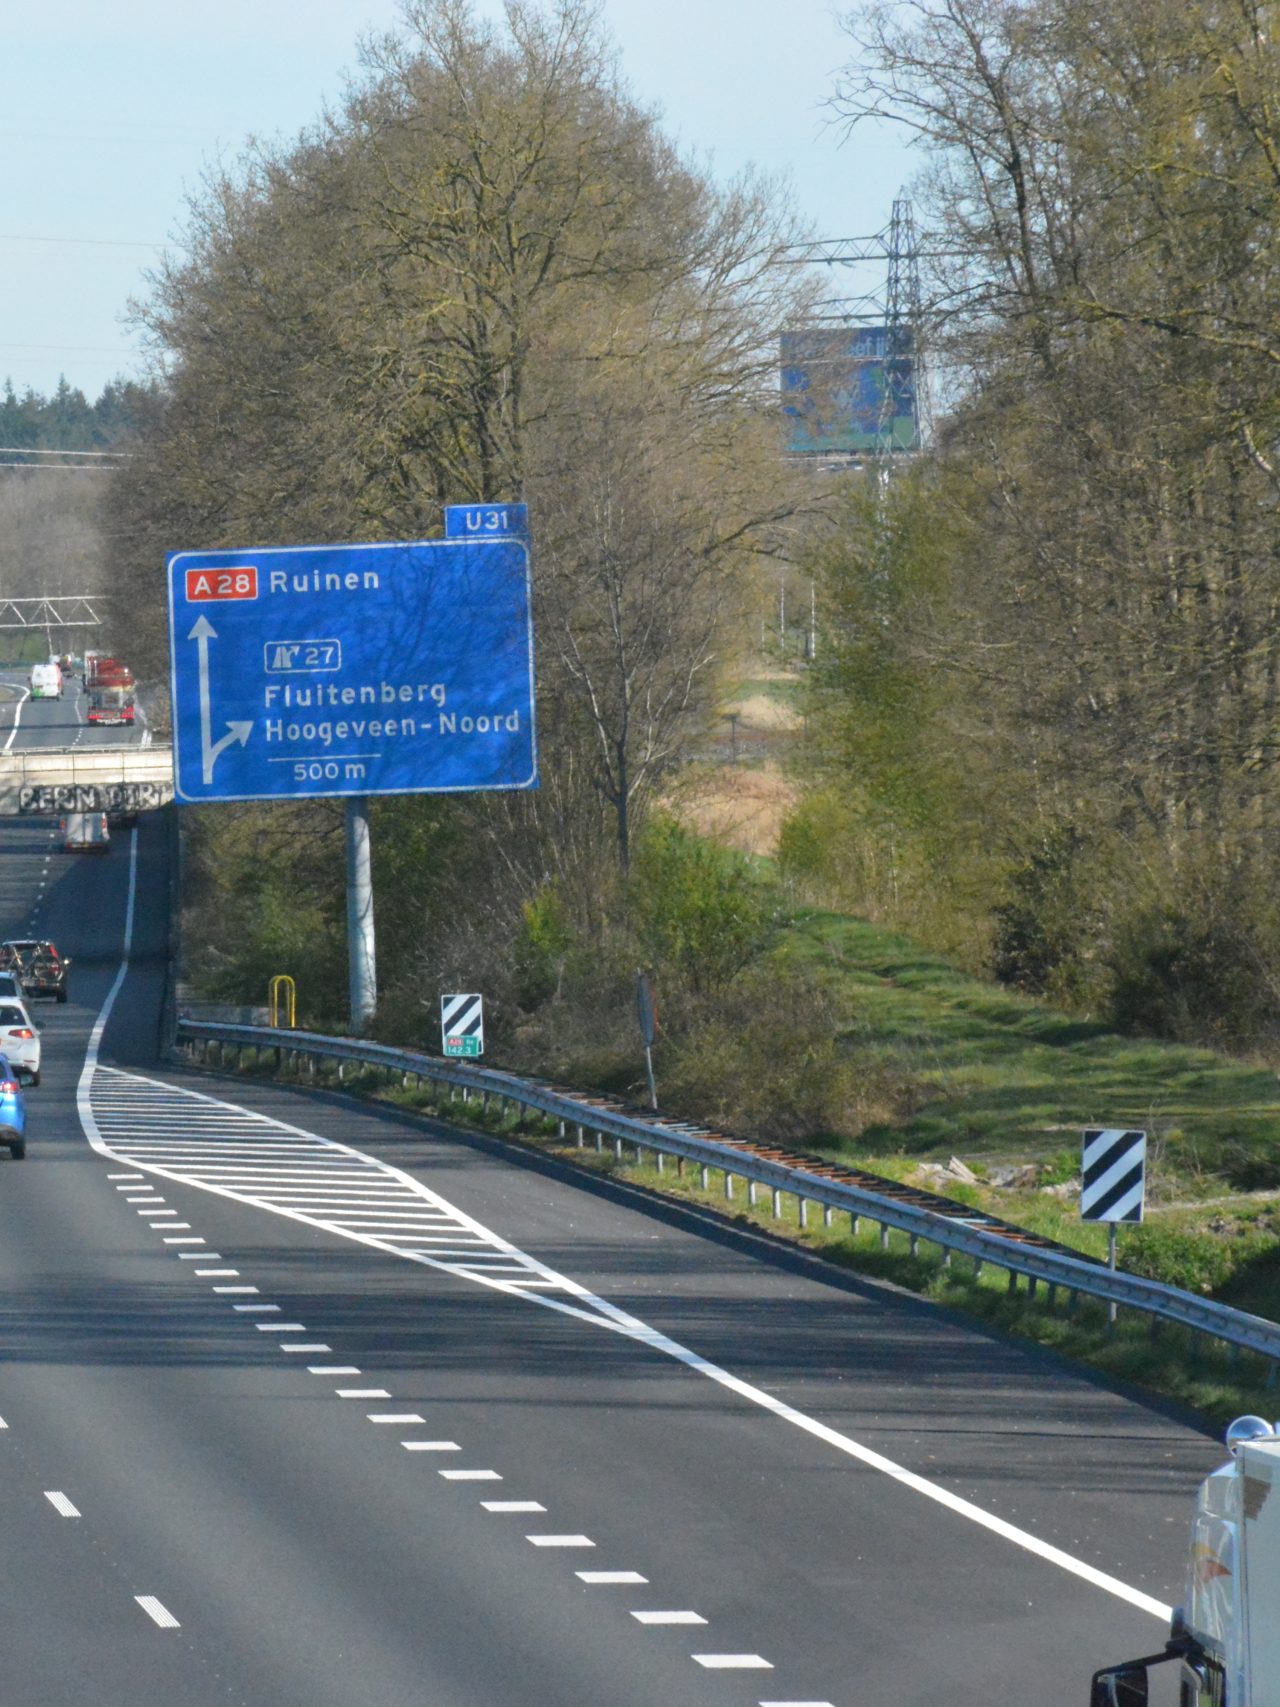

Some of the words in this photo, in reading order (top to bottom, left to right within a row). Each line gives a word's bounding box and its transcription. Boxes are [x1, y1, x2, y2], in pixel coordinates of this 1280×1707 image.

[466, 511, 508, 531] U31
[193, 573, 251, 596] A28
[270, 570, 380, 594] Ruinen
[305, 647, 335, 665] 27
[265, 682, 446, 709] Fluitenberg
[266, 710, 520, 746] Hoogeveen-Noord
[293, 764, 339, 781] 500
[345, 764, 366, 779] m
